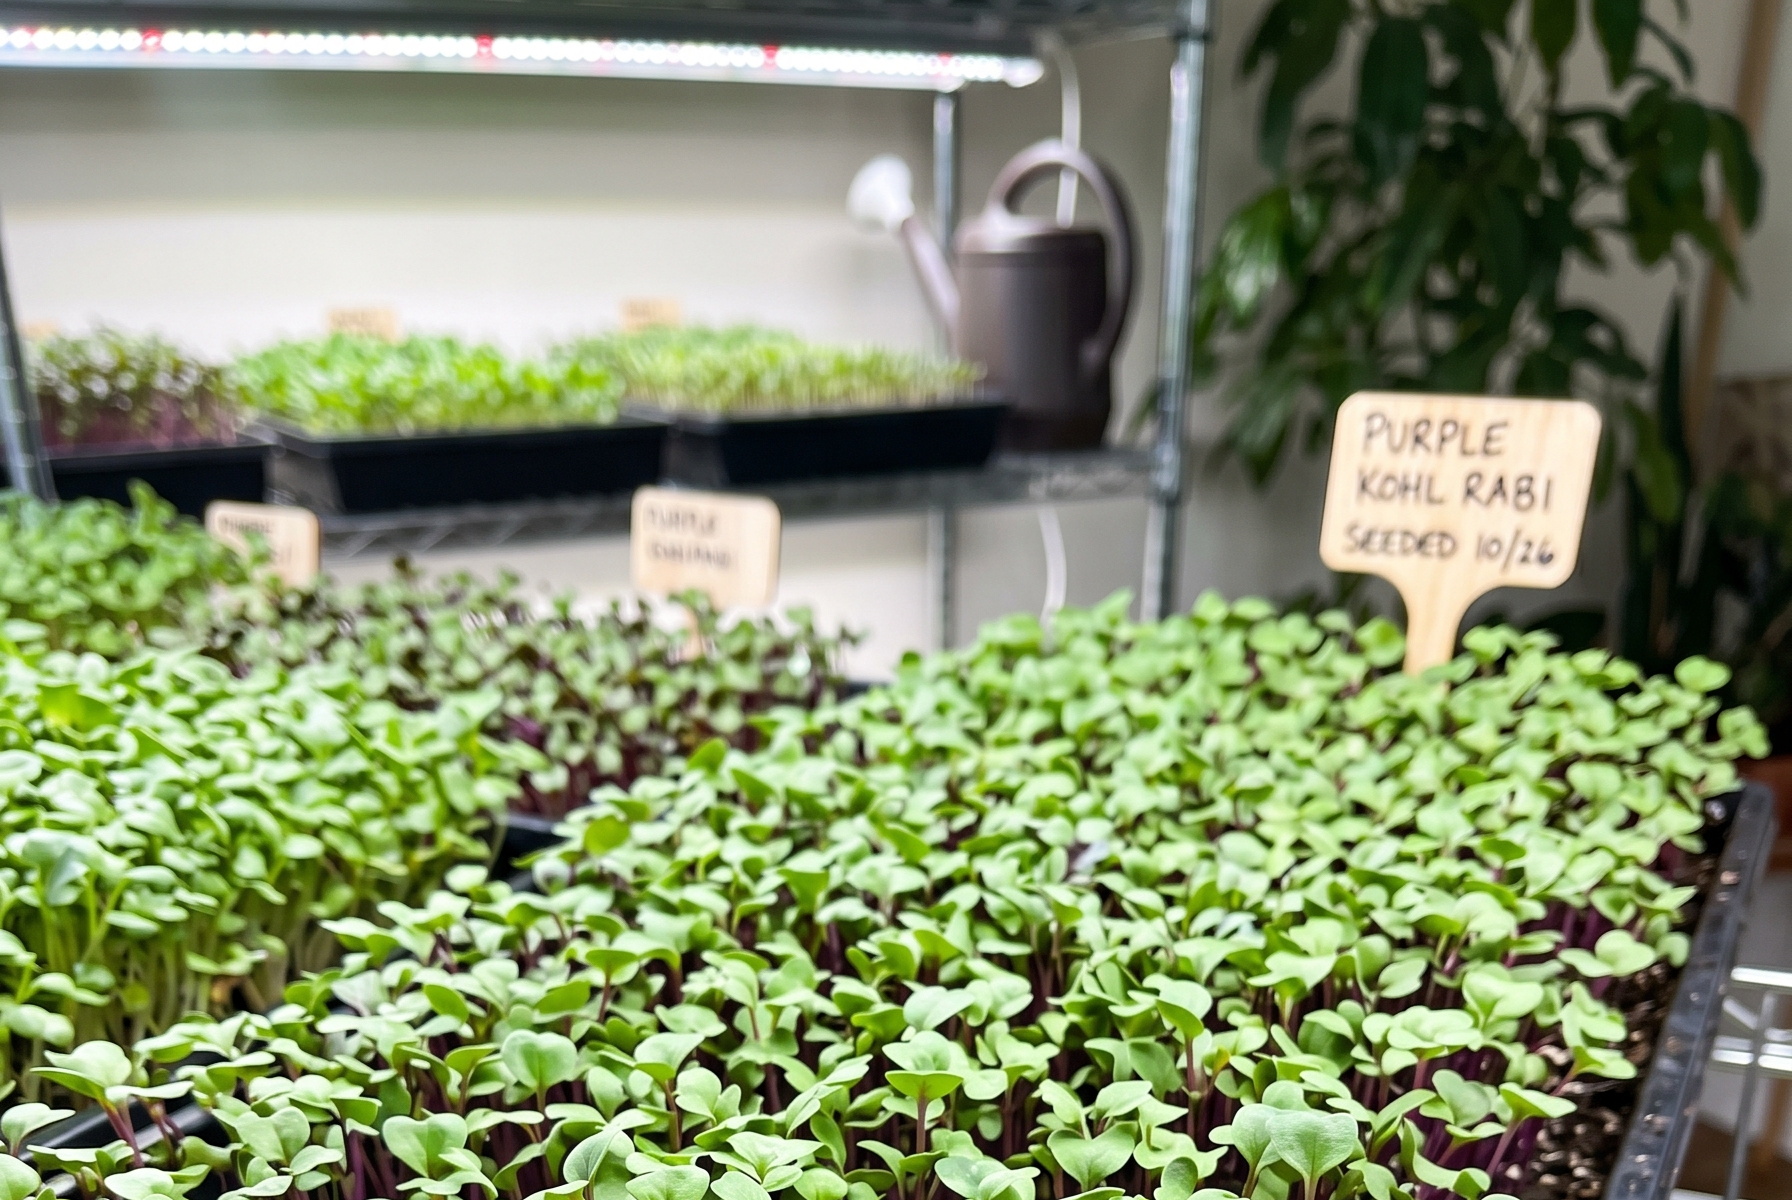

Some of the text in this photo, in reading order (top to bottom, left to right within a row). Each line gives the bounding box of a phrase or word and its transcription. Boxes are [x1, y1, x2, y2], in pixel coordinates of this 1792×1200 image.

[1363, 412, 1510, 456] PURPLE
[1355, 467, 1552, 515] KOHL RABI
[1344, 521, 1555, 573] SEEDED 10/26
